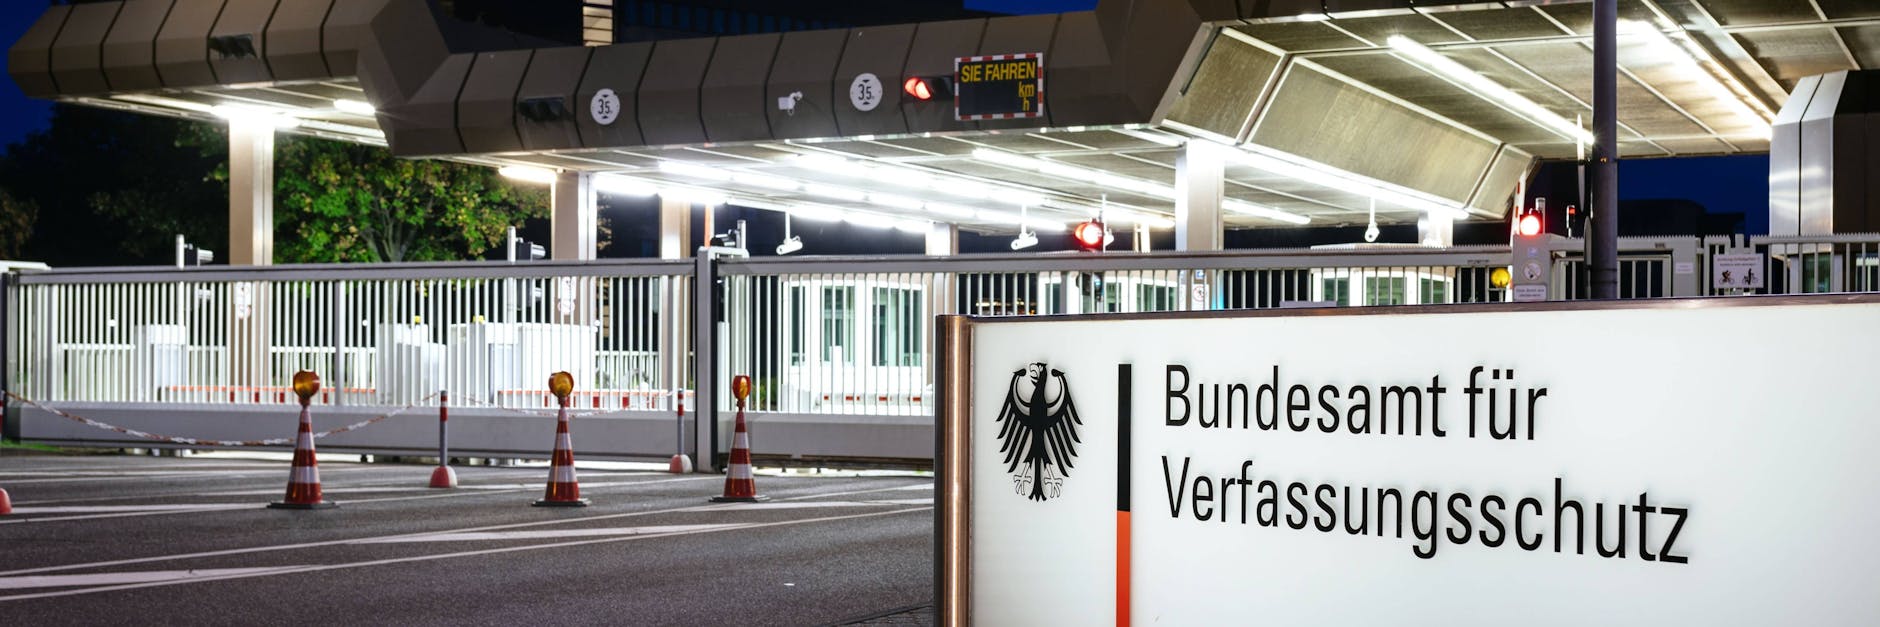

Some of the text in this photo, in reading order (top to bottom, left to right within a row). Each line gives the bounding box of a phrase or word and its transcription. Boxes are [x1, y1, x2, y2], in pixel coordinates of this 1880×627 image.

[961, 61, 1036, 83] SIE FAHREN
[1018, 81, 1035, 98] km
[1022, 97, 1030, 112] h
[1165, 364, 1548, 441] Bundesamt für
[1161, 455, 1689, 565] Verfassungsschutz
